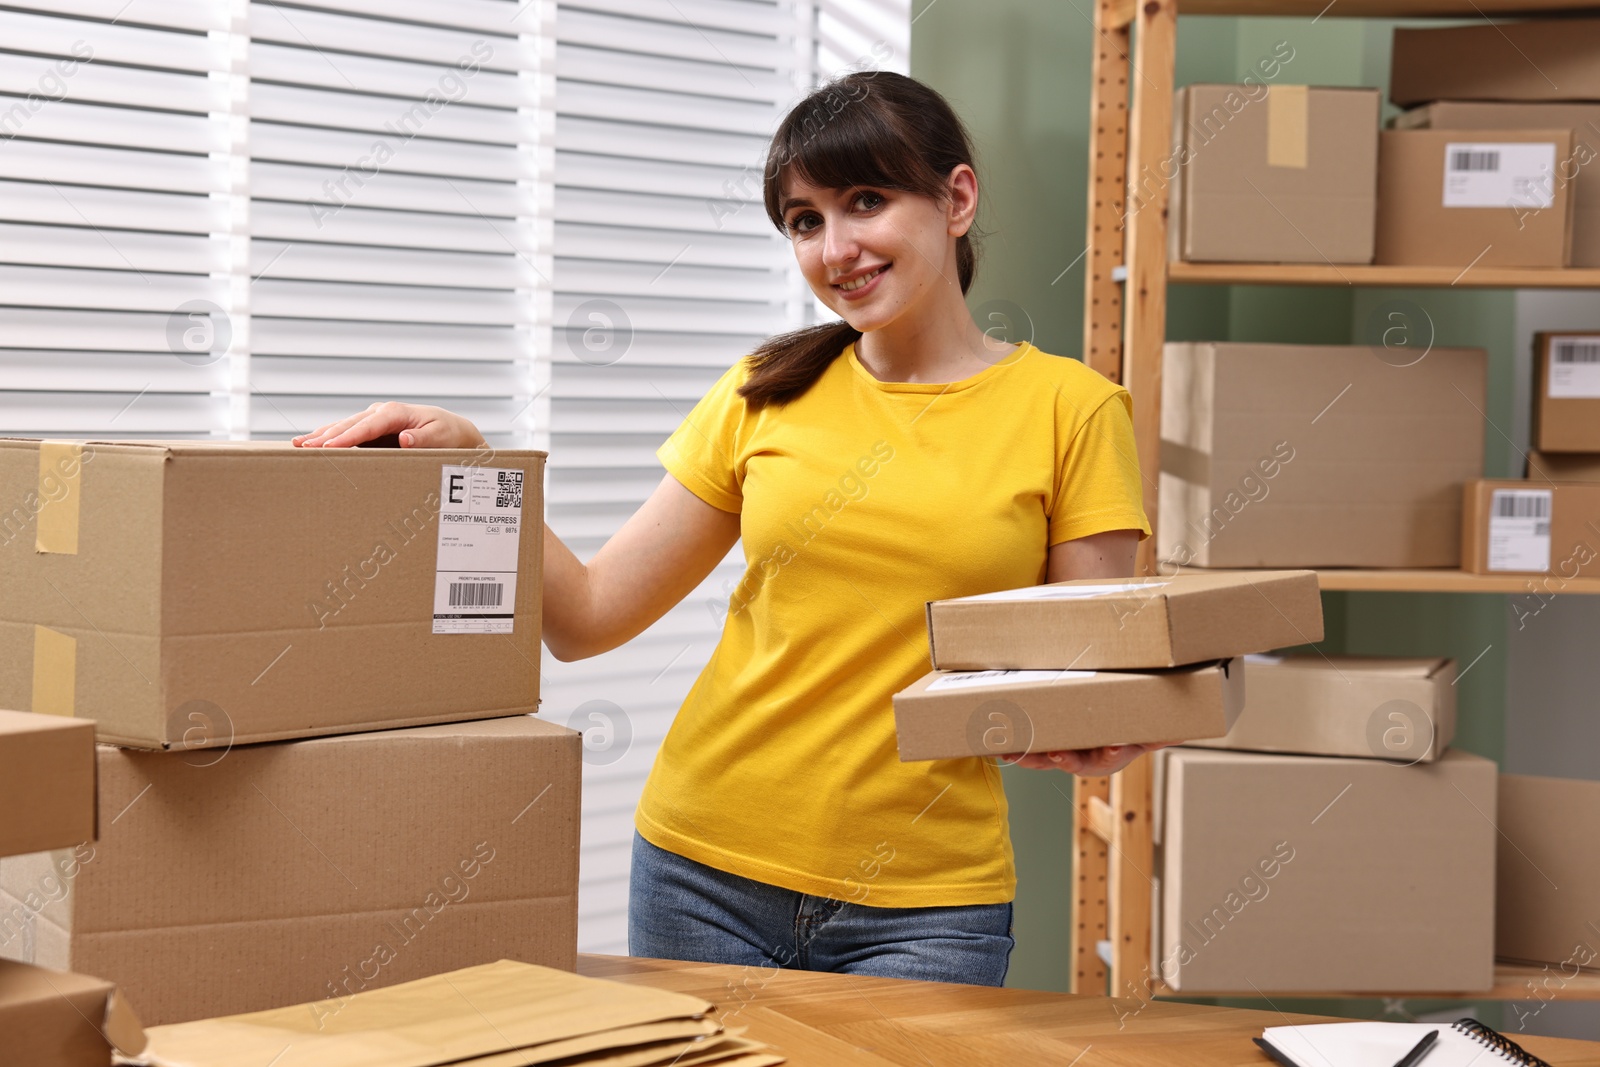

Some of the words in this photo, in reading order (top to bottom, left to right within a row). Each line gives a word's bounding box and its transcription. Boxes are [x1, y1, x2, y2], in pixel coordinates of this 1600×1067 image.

[449, 475, 464, 503] E
[443, 514, 473, 523] PRIORITY
[473, 515, 488, 524] MAIL
[489, 516, 517, 524] EXPRESS
